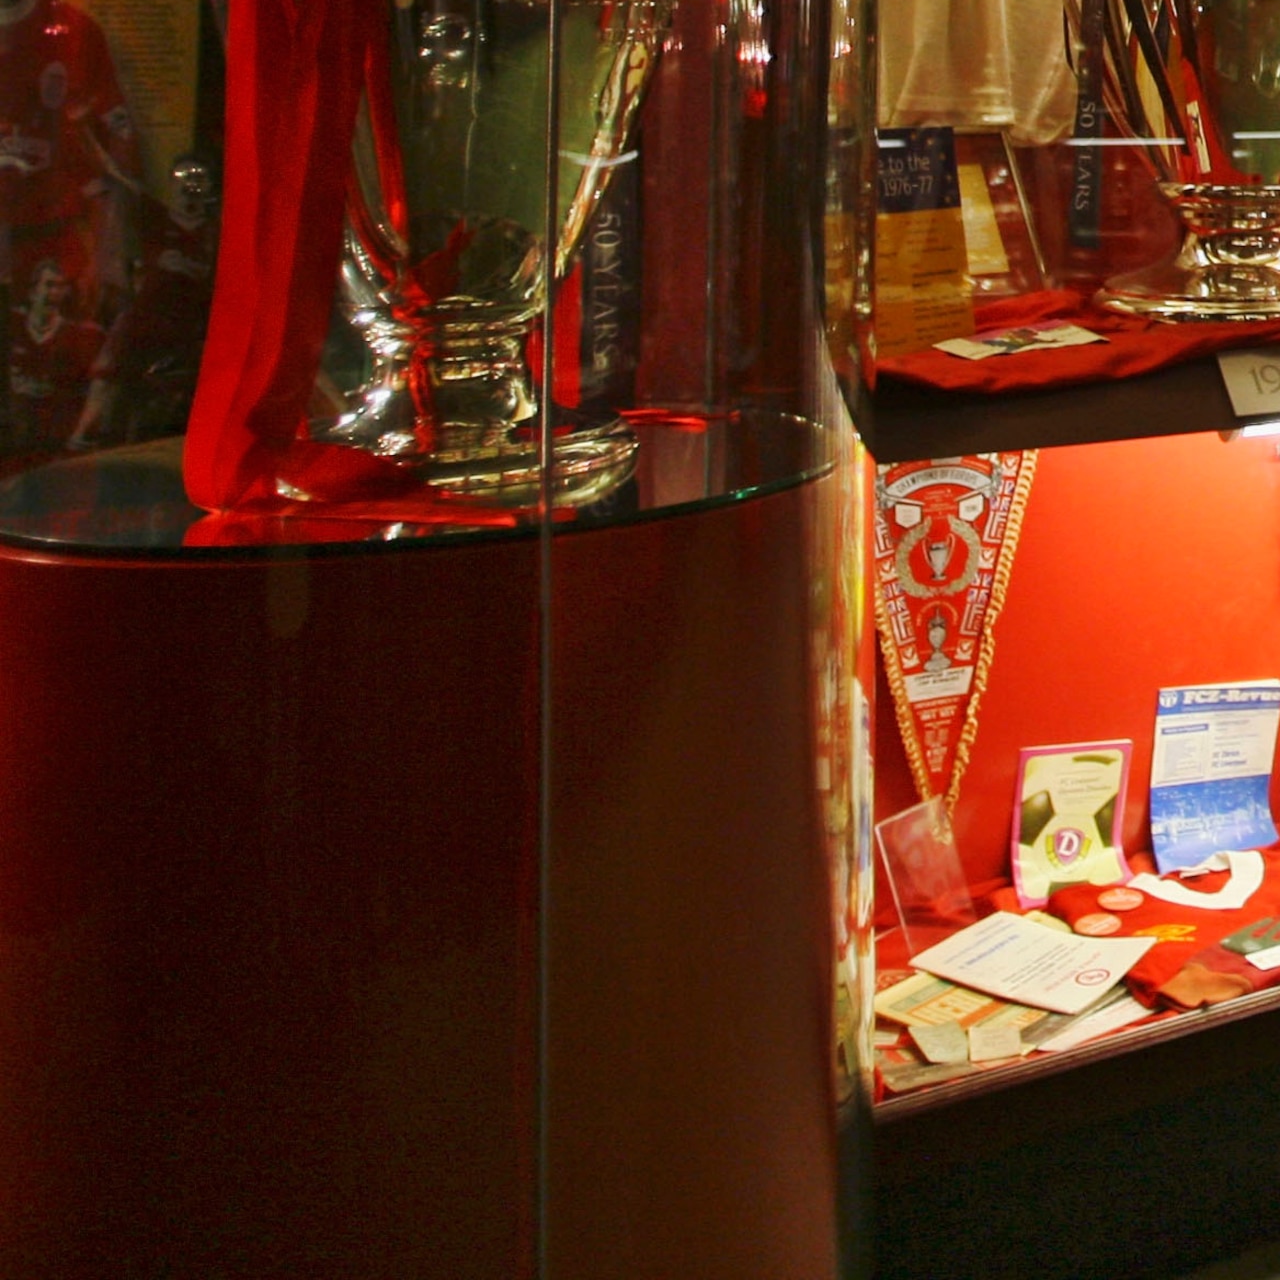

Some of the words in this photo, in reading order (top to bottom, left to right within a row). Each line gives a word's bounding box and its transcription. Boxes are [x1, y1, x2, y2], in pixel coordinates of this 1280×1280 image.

[1079, 101, 1096, 129] 50
[593, 212, 622, 248] 50
[1058, 830, 1080, 856] D
